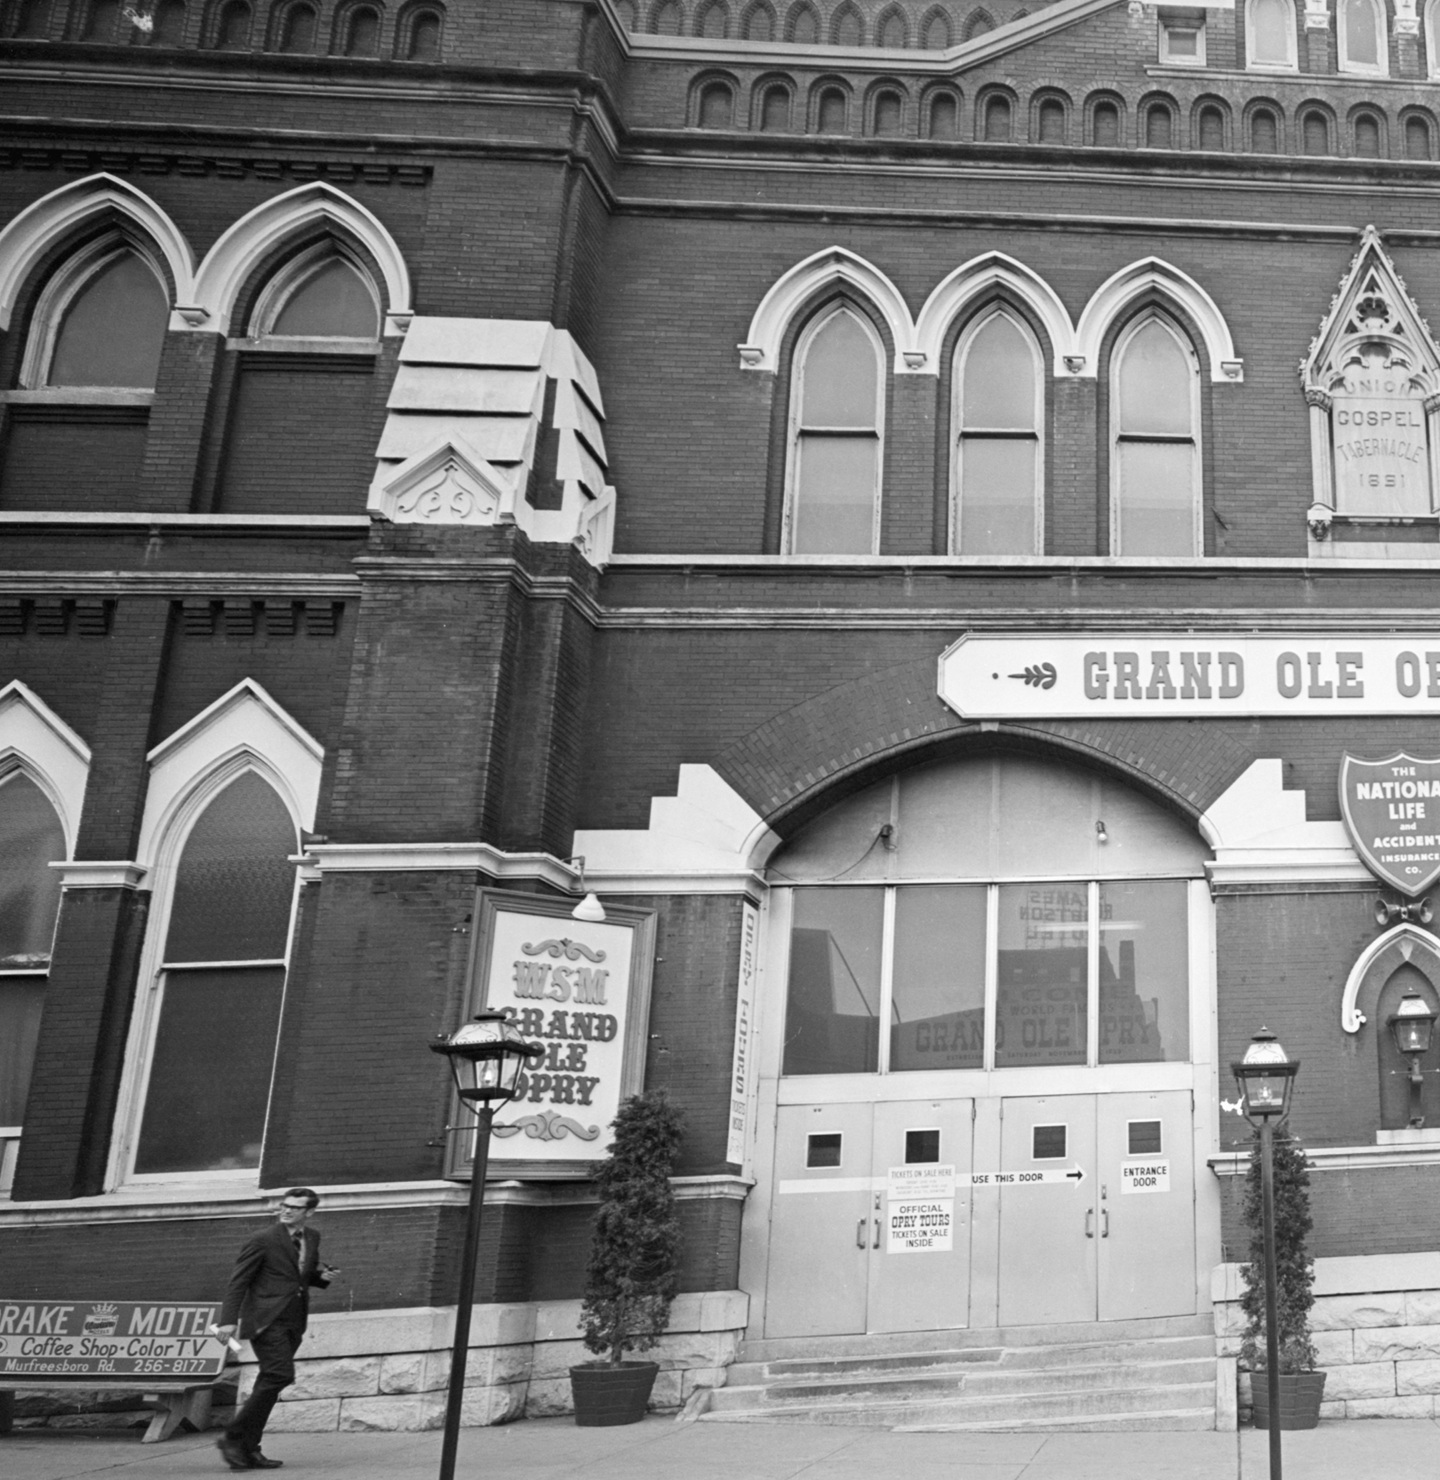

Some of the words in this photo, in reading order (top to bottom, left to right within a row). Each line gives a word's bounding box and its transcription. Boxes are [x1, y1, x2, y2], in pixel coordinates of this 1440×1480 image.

[1344, 379, 1411, 395] UNION
[1337, 410, 1421, 427] GOSPEL
[1336, 438, 1424, 464] TABERNACLE
[1083, 651, 1245, 699] GRAND
[1276, 651, 1365, 698] OLE
[1391, 767, 1416, 776] THE
[1388, 802, 1426, 820] LIFE
[1399, 822, 1417, 831] and
[1381, 853, 1440, 862] INSURANCE
[1405, 866, 1422, 874] CO.
[513, 960, 610, 1005] WSM
[1022, 1017, 1070, 1048] OLE
[1102, 1015, 1150, 1045] PRY
[891, 1170, 913, 1179] TICKETS
[914, 1169, 922, 1178] ON
[923, 1168, 937, 1178] SALE
[1123, 1166, 1167, 1177] ENTRANCE
[972, 1175, 989, 1184] USE
[995, 1174, 1015, 1183] THIS
[1019, 1173, 1044, 1181] DOOR
[1133, 1177, 1157, 1187] DOOR
[899, 1205, 943, 1214] OFFICIAL
[891, 1215, 918, 1228] OPRY
[919, 1213, 950, 1227] TOURS
[892, 1230, 917, 1239] TICKETS
[918, 1229, 928, 1238] ON
[929, 1228, 948, 1237] SALE
[906, 1238, 934, 1248] INSIDE
[0, 1305, 75, 1335] RAKE
[128, 1306, 217, 1336] MOTEL
[20, 1337, 74, 1356] Coffee
[80, 1338, 119, 1358] Shop
[126, 1338, 174, 1356] Color
[175, 1338, 208, 1356] TV
[4, 1358, 90, 1372] Murfreesboro
[97, 1359, 117, 1373] Rd.
[133, 1359, 207, 1372] 256-8177
